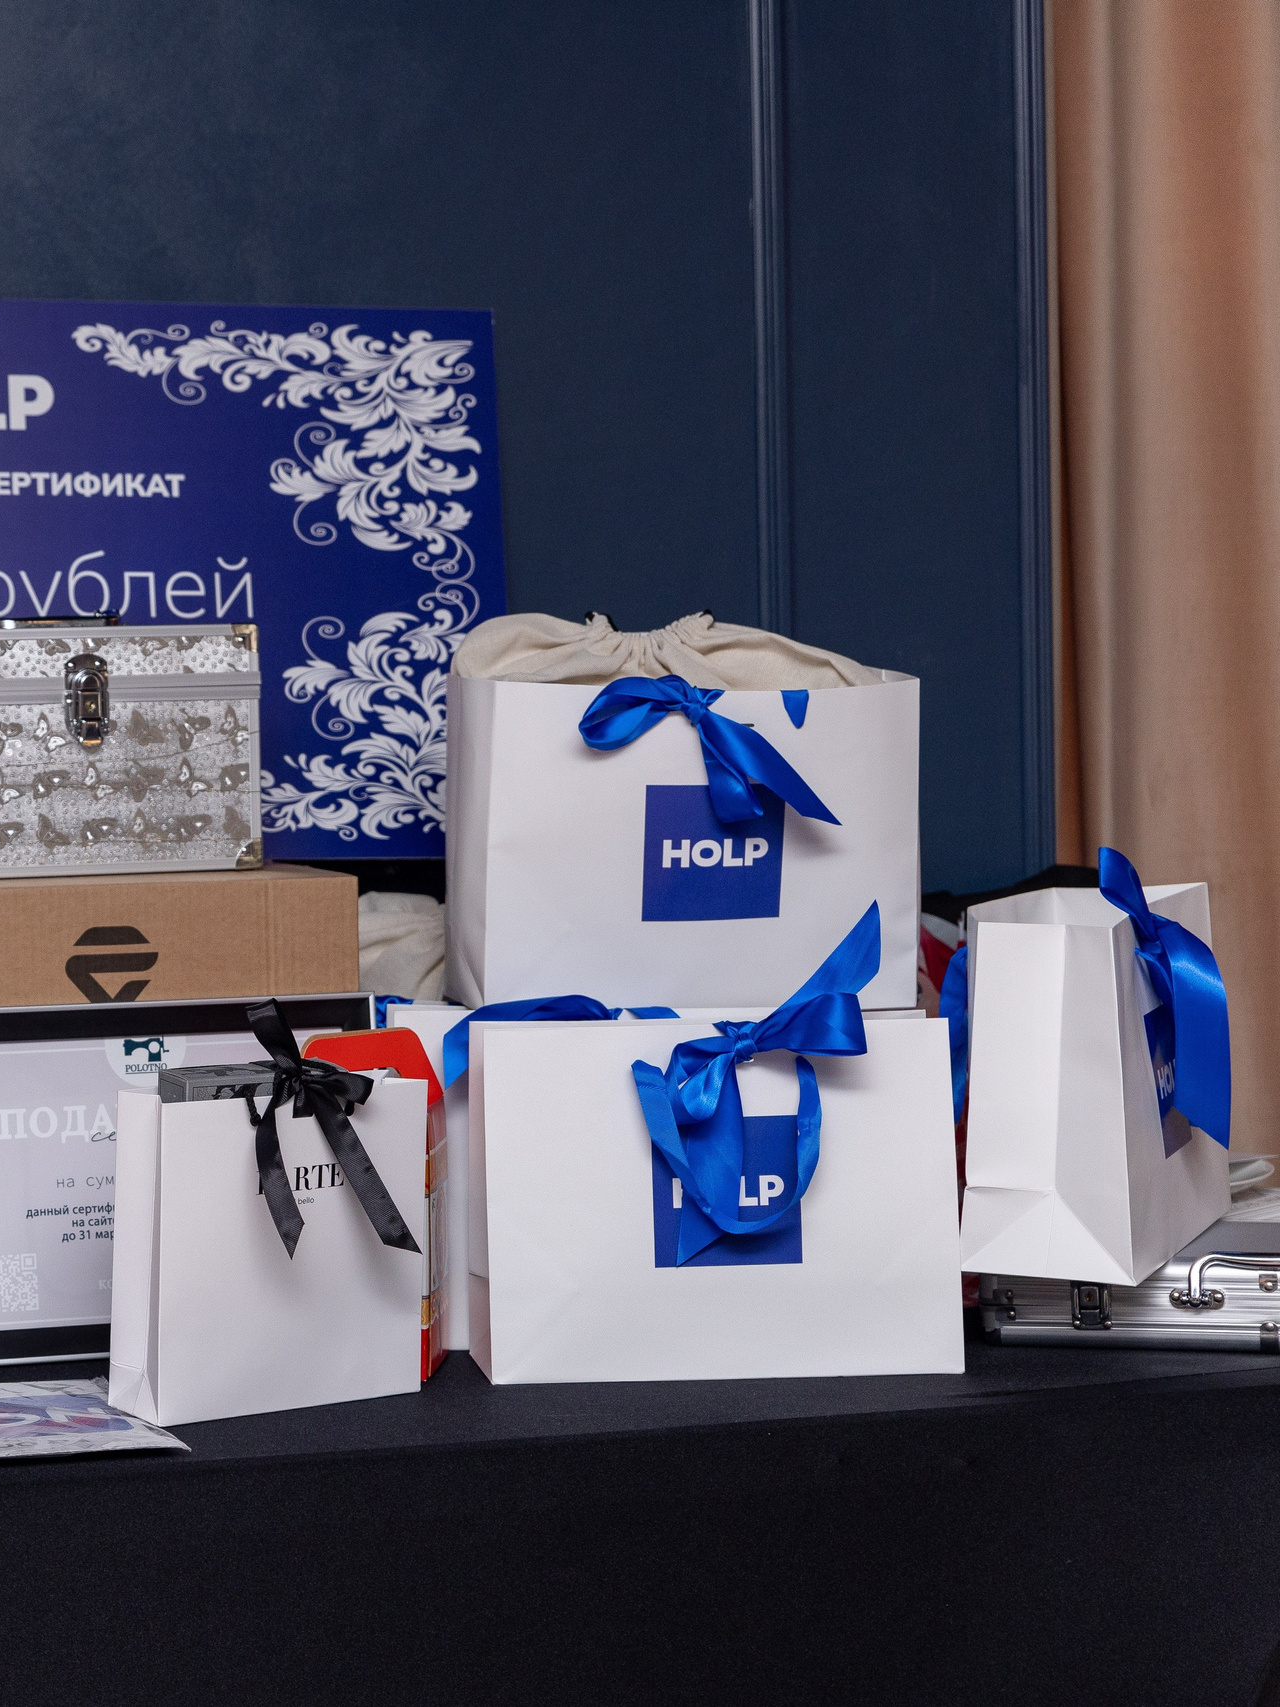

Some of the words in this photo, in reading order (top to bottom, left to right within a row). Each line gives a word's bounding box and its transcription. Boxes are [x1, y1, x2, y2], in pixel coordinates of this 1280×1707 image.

[662, 837, 769, 868] HOLP
[125, 1063, 168, 1073] POLOTNO
[56, 1177, 75, 1188] на
[26, 1205, 70, 1219] данный
[72, 1218, 85, 1227] на
[62, 1232, 76, 1243] до
[79, 1230, 91, 1240] 31
